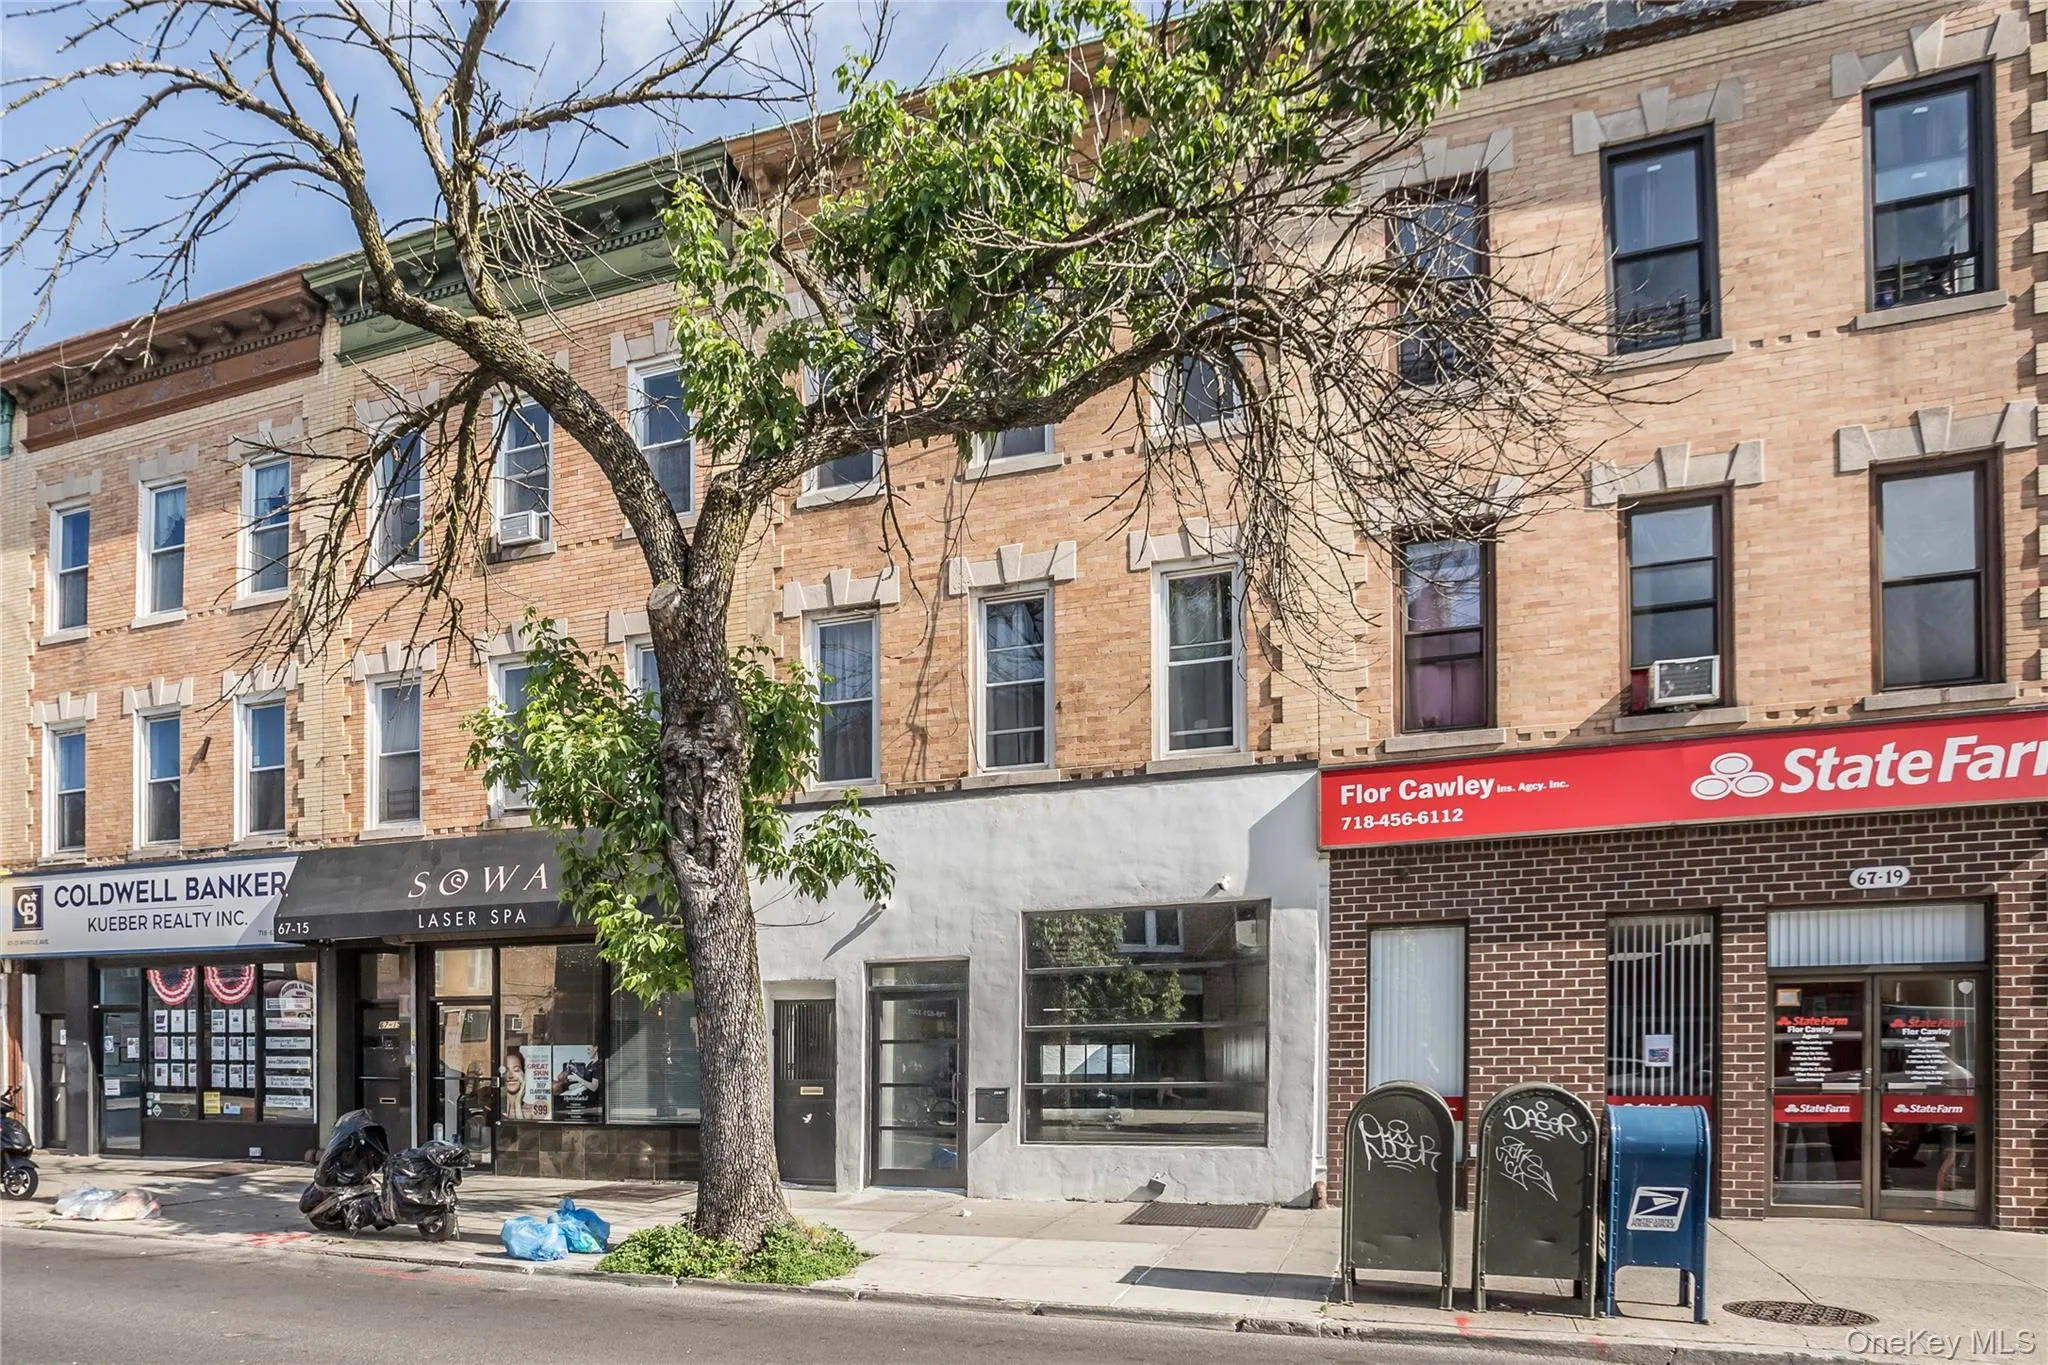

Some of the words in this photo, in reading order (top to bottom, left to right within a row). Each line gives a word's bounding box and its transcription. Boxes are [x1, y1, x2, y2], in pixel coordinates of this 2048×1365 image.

[1340, 783, 1392, 805] Flor
[1398, 775, 1495, 800] Cawley
[1496, 783, 1516, 794] Ins.
[1518, 781, 1546, 794] Agcy.
[1548, 779, 1569, 790] Inc.
[1340, 807, 1464, 831] 718-456-6112
[407, 862, 549, 898] SOWA
[1855, 869, 1904, 886] 67-19
[54, 878, 177, 909] COLDWELL
[185, 871, 287, 901] BANKER
[88, 914, 147, 933] KUEBER
[153, 911, 211, 930] REALTY
[216, 909, 248, 927] INC.
[278, 922, 310, 935] 67-15
[418, 910, 477, 929] LASER
[490, 908, 527, 925] SPA
[1804, 1026, 1835, 1034] Cawley
[1920, 1028, 1952, 1036] Cawley
[533, 1104, 548, 1116] $99
